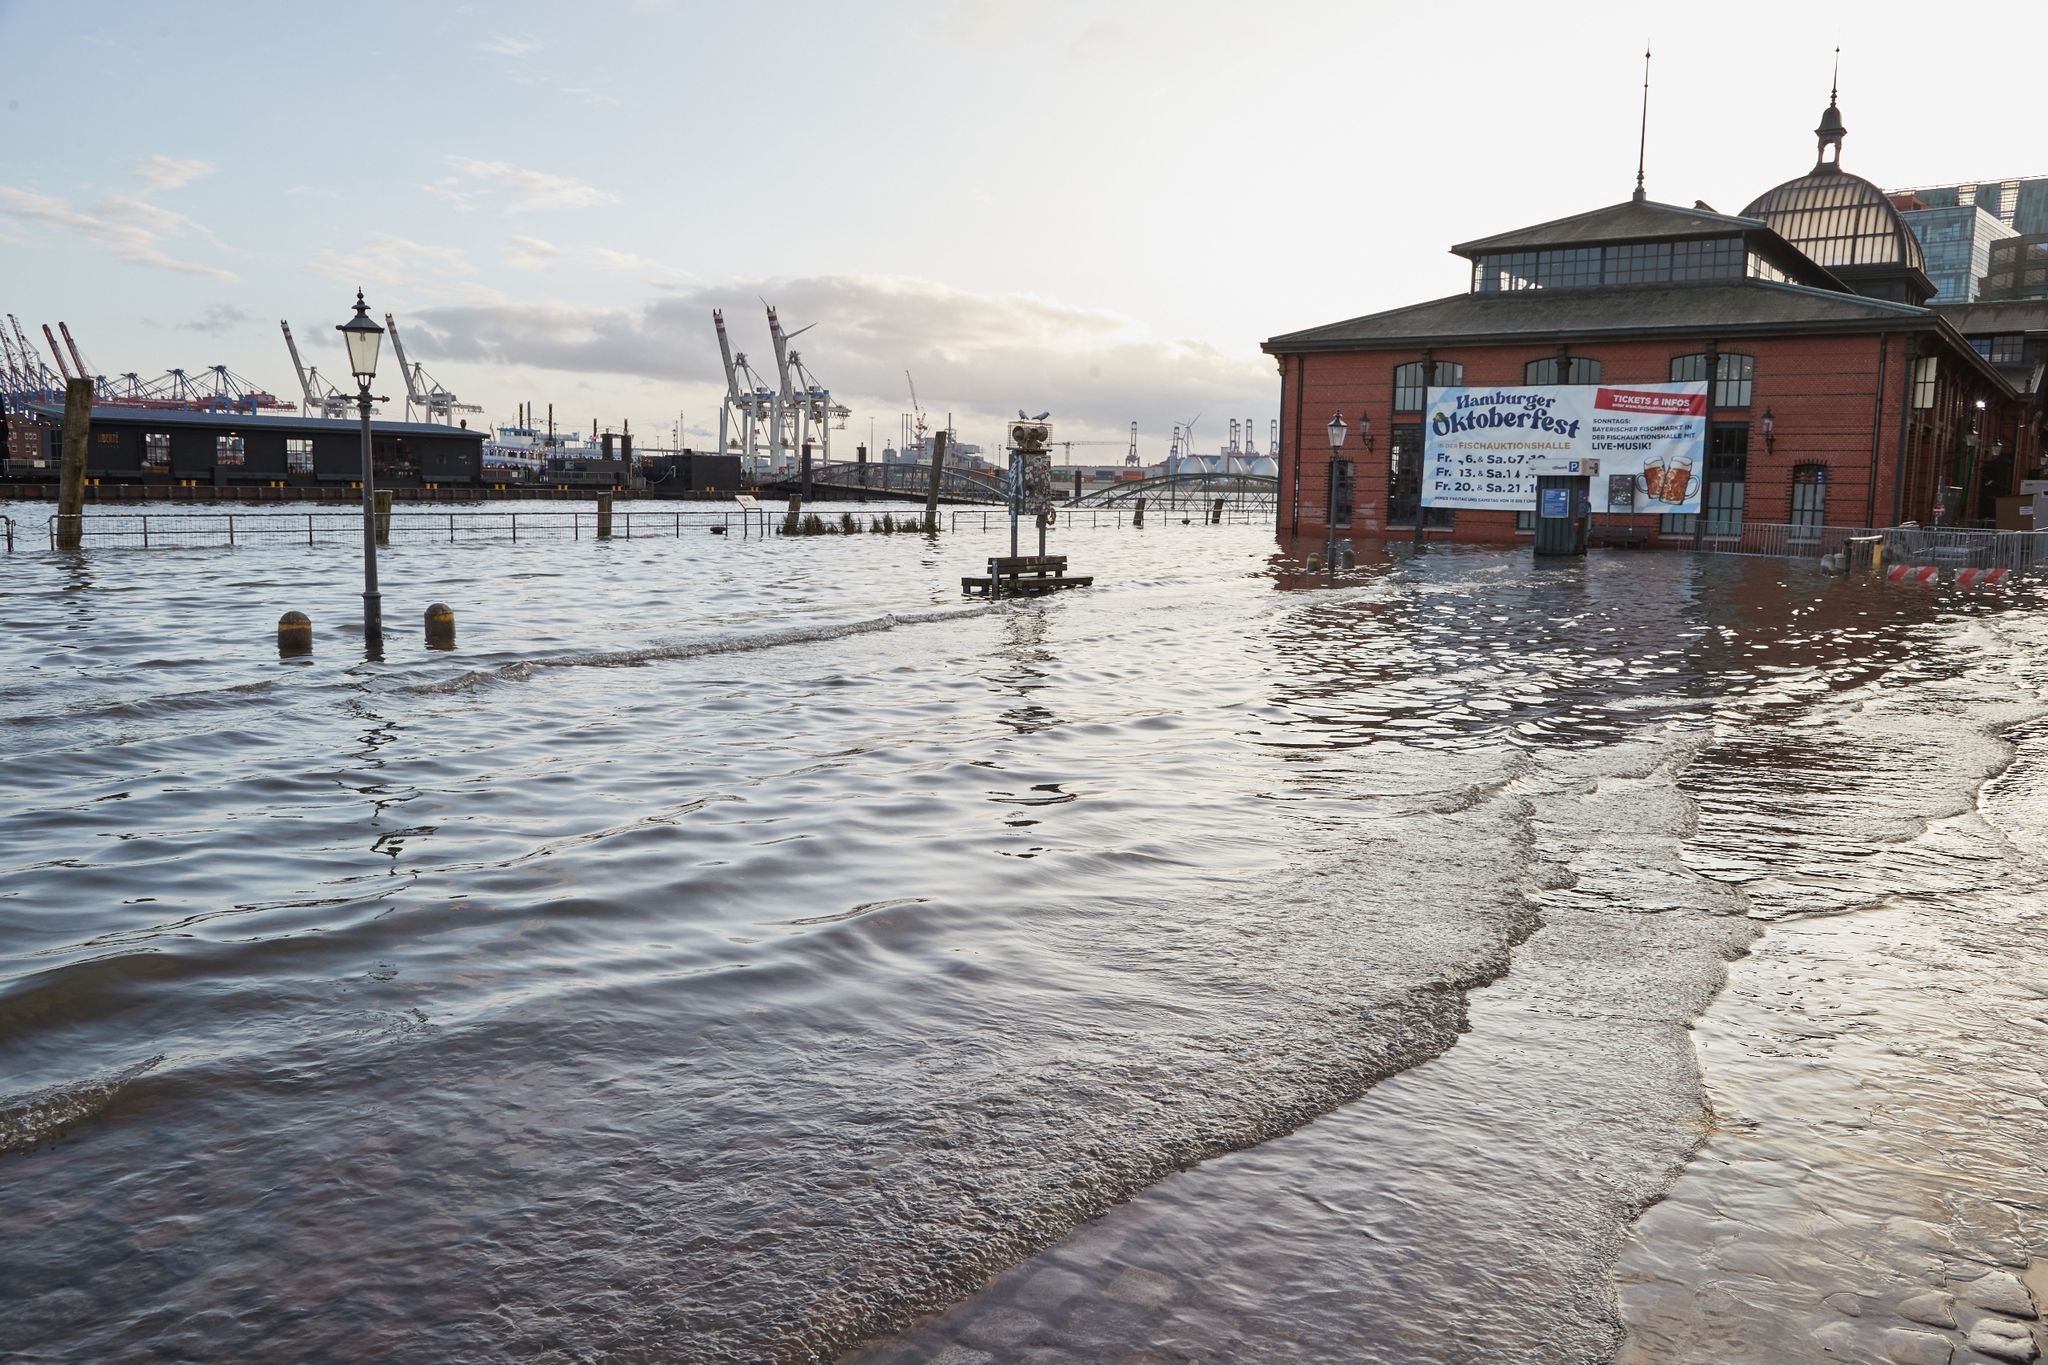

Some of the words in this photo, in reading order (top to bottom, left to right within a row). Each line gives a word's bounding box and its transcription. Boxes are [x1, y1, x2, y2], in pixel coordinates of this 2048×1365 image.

[1456, 391, 1556, 411] Hamburger
[1613, 394, 1651, 405] TICKETS
[1653, 398, 1660, 406] &
[1661, 398, 1690, 407] INFOS
[1432, 406, 1580, 438] Oktoberfest
[1458, 442, 1571, 450] FISCHAUKTIONSHALLE
[1592, 442, 1652, 450] LIVE-MUSIK!
[1437, 453, 1452, 463] Fr.
[1571, 462, 1578, 471] P
[1436, 467, 1452, 477] Fr.
[1459, 468, 1476, 478] 13.
[1435, 481, 1451, 491] Fr.
[1454, 482, 1475, 492] 20.
